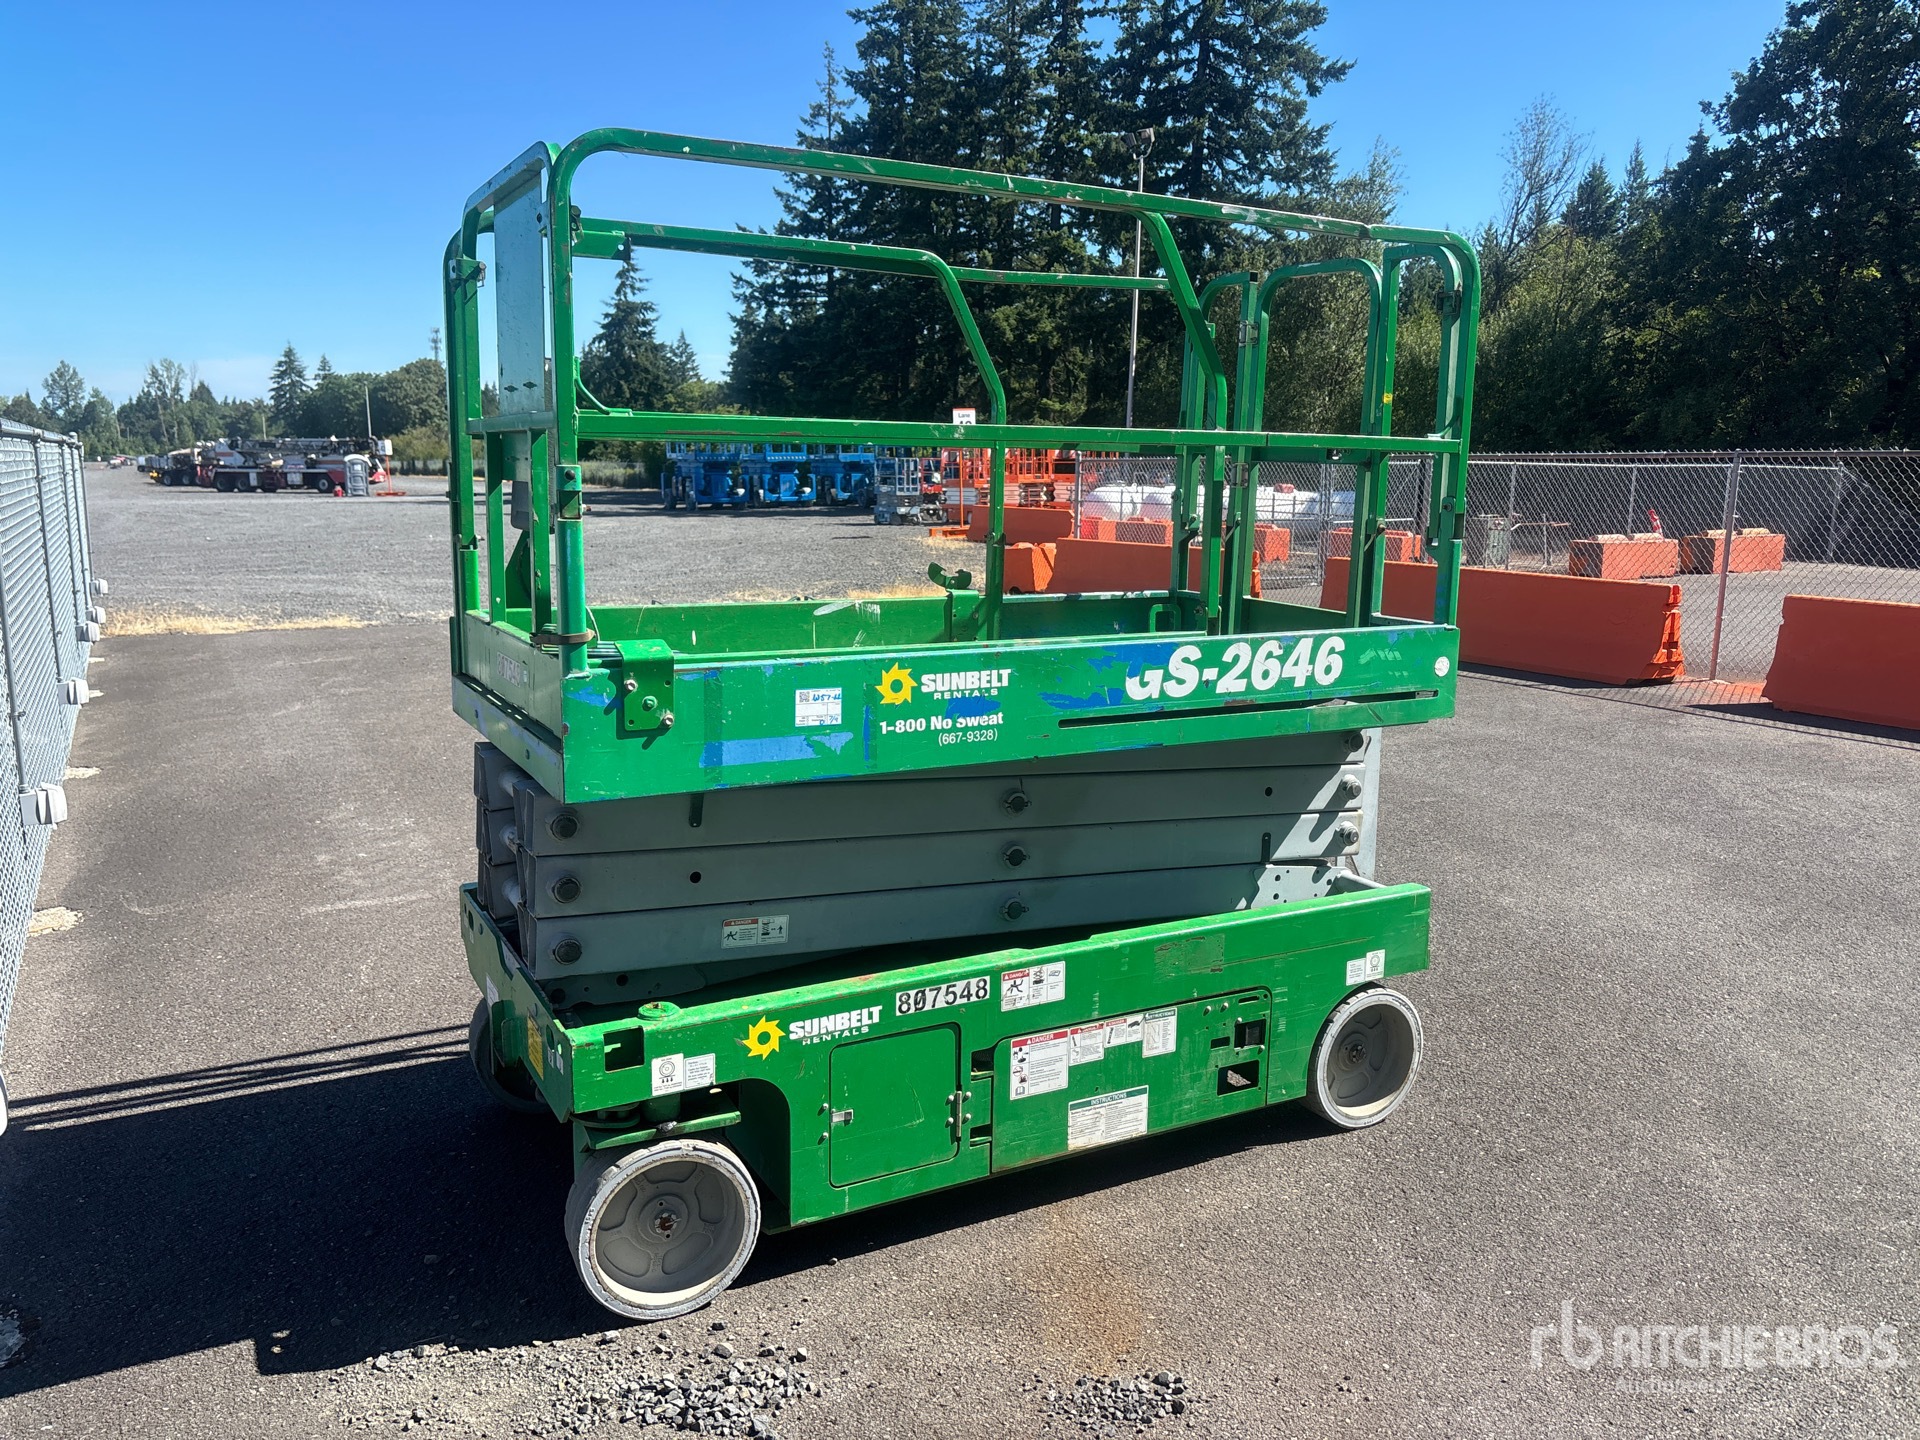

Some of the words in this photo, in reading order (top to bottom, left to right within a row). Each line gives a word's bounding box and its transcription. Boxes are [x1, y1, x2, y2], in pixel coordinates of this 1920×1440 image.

[1125, 636, 1345, 700] GS-2646
[921, 669, 1012, 693] SUNBELT
[933, 688, 999, 700] RENTALS
[880, 718, 926, 734] 1-800
[930, 716, 952, 730] No
[956, 712, 1004, 728] Sweat
[938, 728, 998, 747] (667-9328)
[897, 978, 988, 1014] 807548
[789, 1005, 882, 1040] SUNBELT
[802, 1026, 869, 1045] RENTALS
[1031, 1034, 1054, 1044] DANGER
[1090, 1092, 1127, 1105] INSTRUCTIONS
